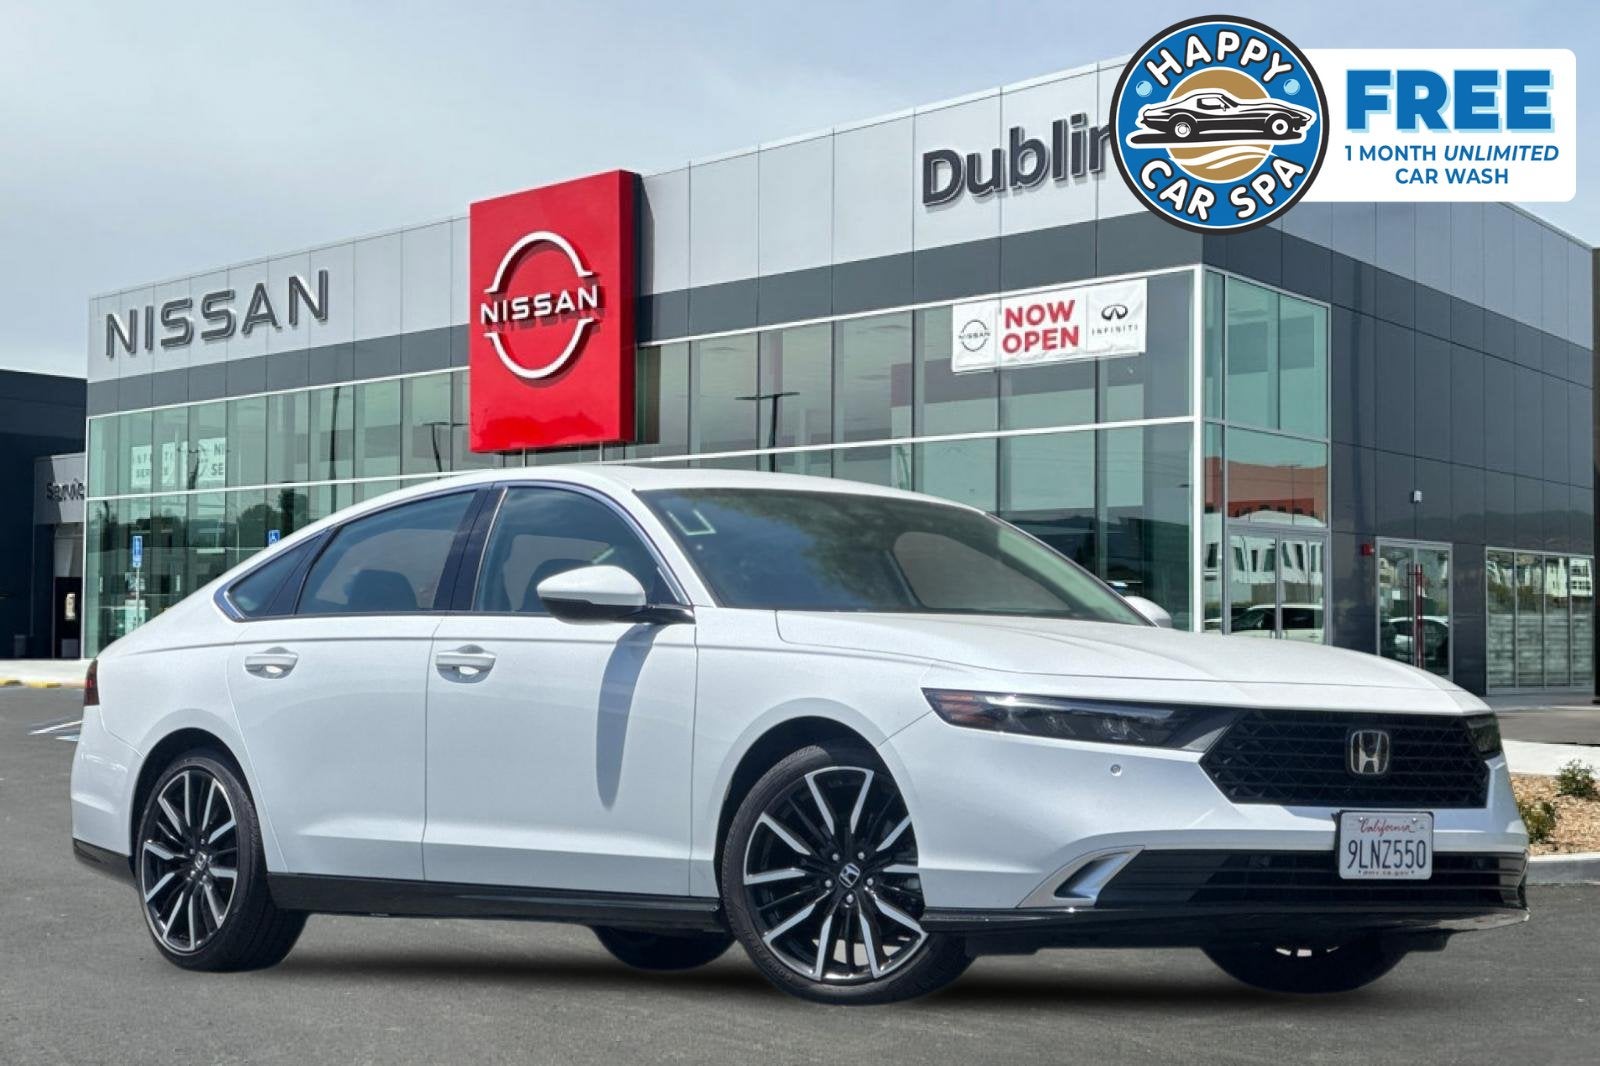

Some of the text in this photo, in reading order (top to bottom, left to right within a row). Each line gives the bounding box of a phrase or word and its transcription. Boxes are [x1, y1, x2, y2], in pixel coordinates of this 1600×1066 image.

[105, 269, 329, 358] NISSAN
[480, 284, 598, 325] NISSAN
[1005, 300, 1075, 329] NOW
[1002, 325, 1079, 354] OPEN
[1091, 324, 1138, 336] INFINITI
[1359, 818, 1415, 837] California
[1347, 839, 1426, 869] 9LNZ550
